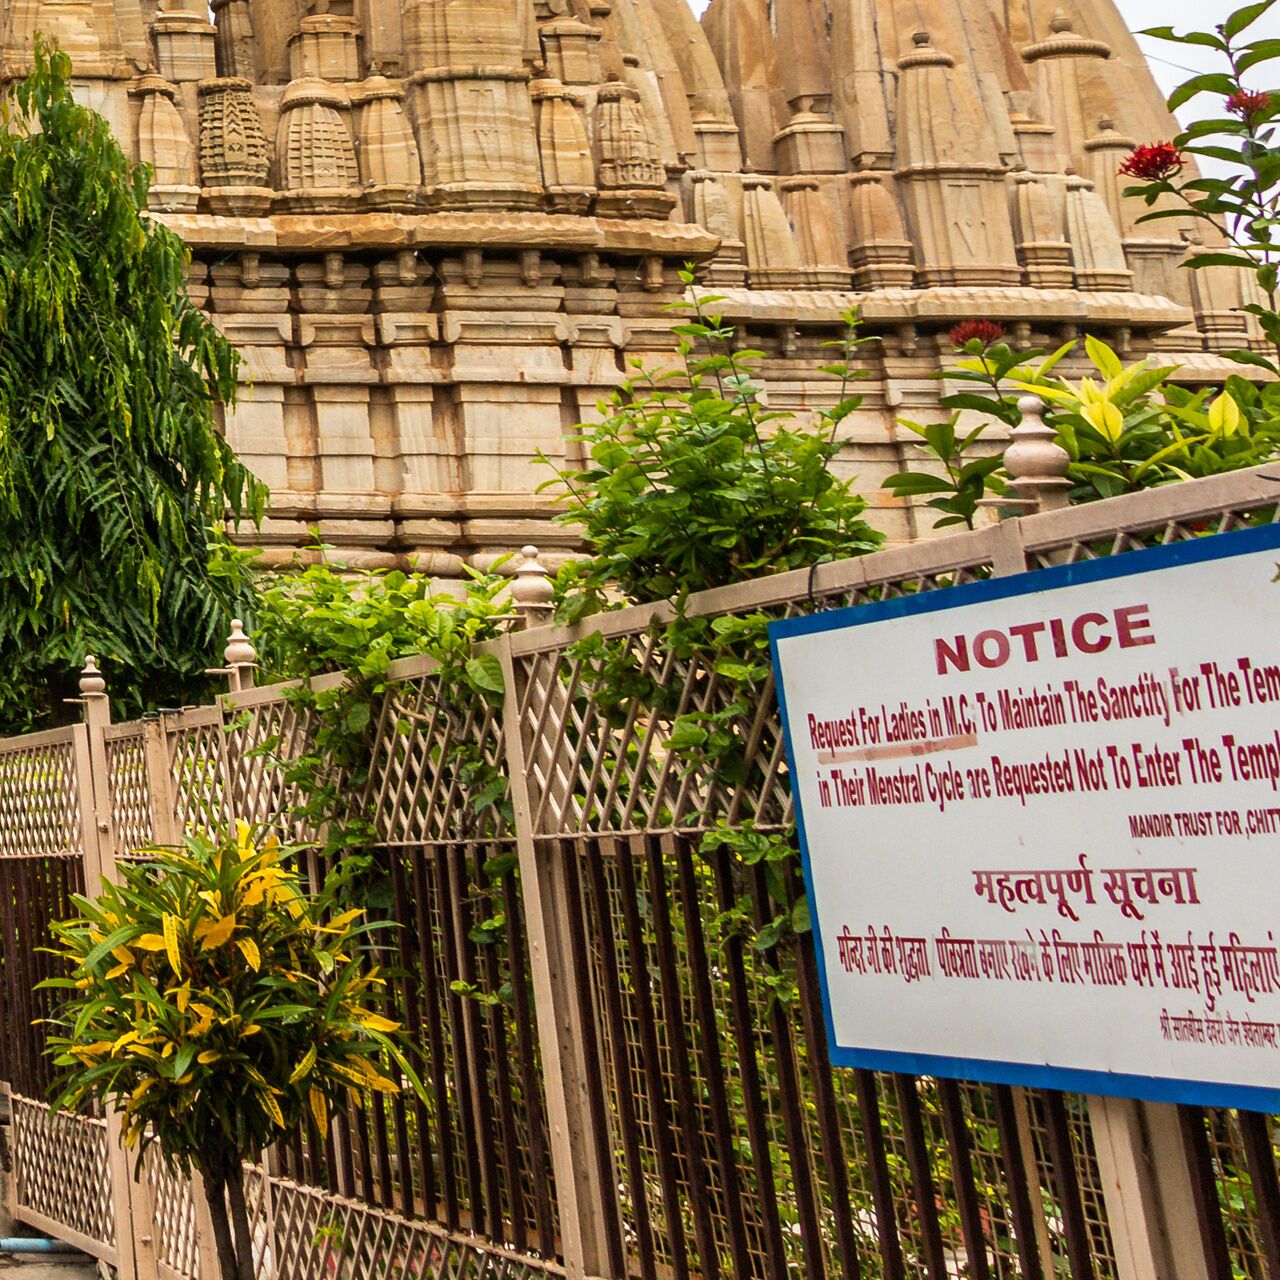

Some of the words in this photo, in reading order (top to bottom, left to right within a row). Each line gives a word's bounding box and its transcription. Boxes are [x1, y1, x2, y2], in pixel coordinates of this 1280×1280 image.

[933, 604, 1156, 676] NOTICE
[807, 709, 859, 758] Request
[859, 708, 881, 744] For
[881, 702, 927, 743] Ladies
[926, 699, 943, 737] in
[975, 692, 997, 732] To
[997, 683, 1066, 730] Maintain
[1063, 680, 1098, 723] The
[1097, 671, 1170, 727] Sanctity
[1168, 667, 1201, 712] For
[1199, 661, 1241, 708] The
[816, 770, 832, 807] in
[831, 768, 865, 806] Their
[865, 763, 925, 805] Menstral
[925, 761, 964, 812] Cycle
[966, 767, 991, 799] are
[991, 749, 1074, 806] Requested
[1074, 747, 1107, 792] Not
[1106, 745, 1131, 789] To
[1131, 741, 1182, 787] Enter
[1182, 738, 1222, 784] The
[1128, 813, 1174, 838] MANDIR
[1174, 811, 1213, 837] TRUST
[1215, 810, 1242, 835] FOR
[972, 853, 1096, 921] महत्वपूर्ण
[1100, 868, 1200, 920] सूचना
[864, 925, 882, 973] जी
[879, 925, 897, 973] की
[935, 926, 979, 978] पवित्रता
[1038, 929, 1054, 982] के
[1051, 928, 1085, 985] लिए
[1080, 929, 1127, 986] मासिक
[1126, 930, 1154, 987] धर्म
[1150, 929, 1168, 988] में
[1166, 930, 1200, 994] आई
[1198, 931, 1222, 1012] हुई
